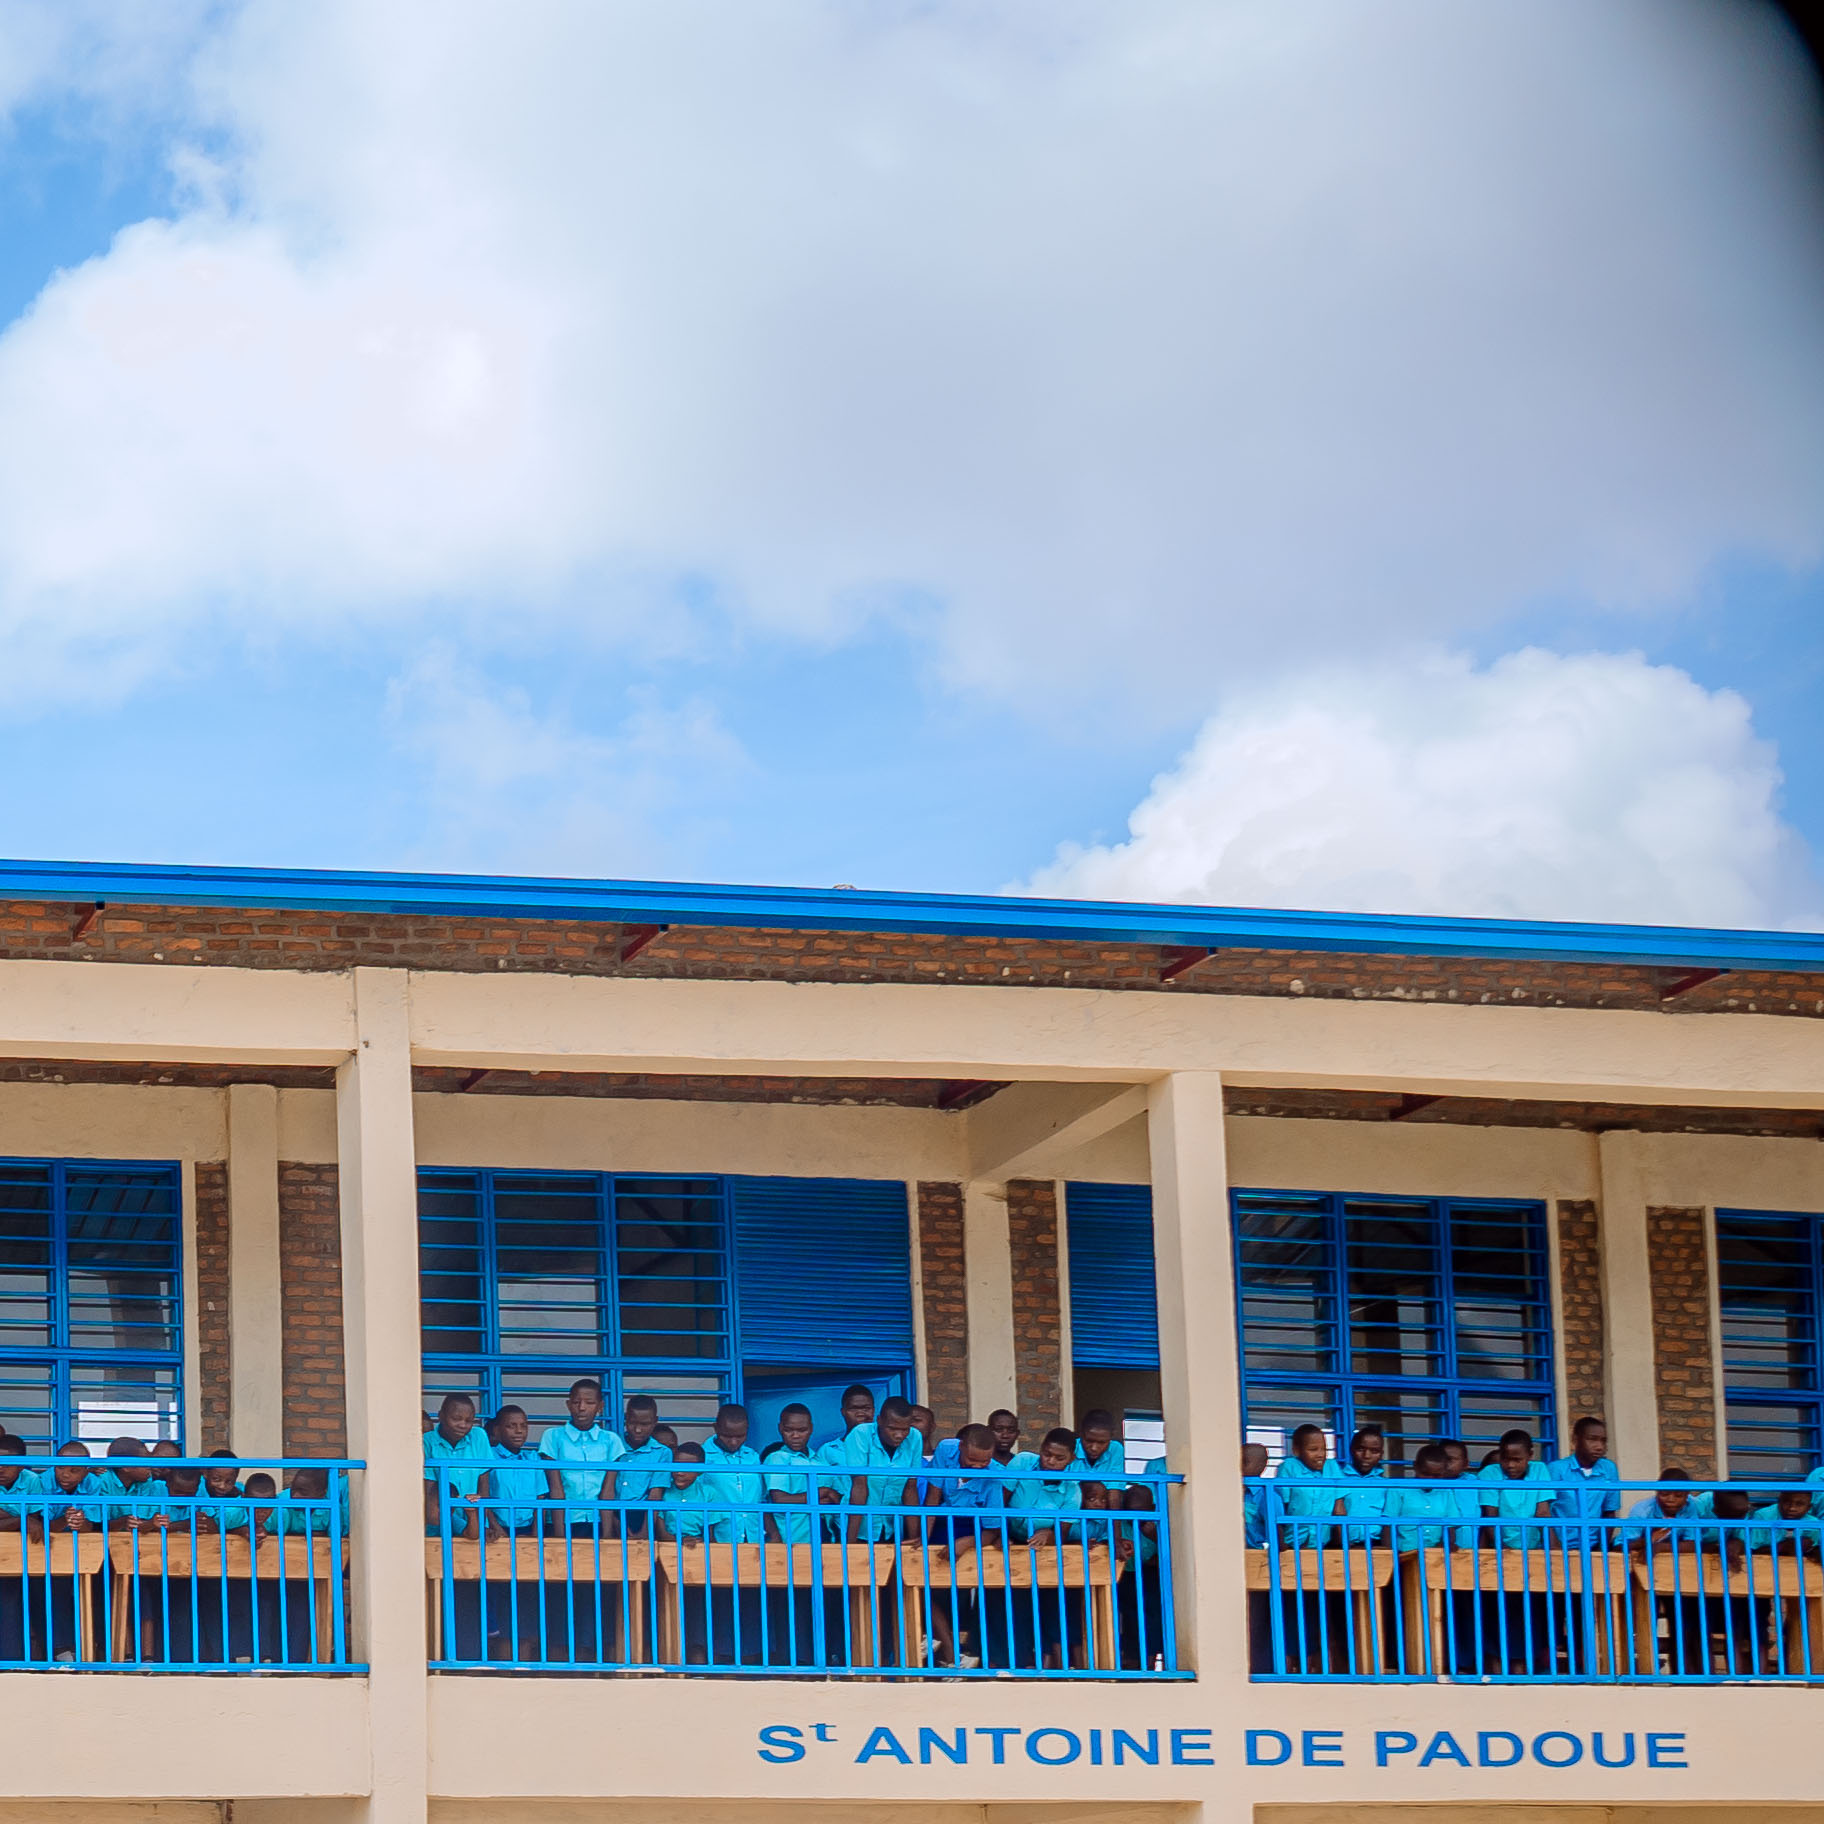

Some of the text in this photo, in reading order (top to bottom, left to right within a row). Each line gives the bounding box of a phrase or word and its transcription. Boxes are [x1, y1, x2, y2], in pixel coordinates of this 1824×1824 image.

[758, 1722, 1689, 1769] St ANTOINE DE PADOUE
